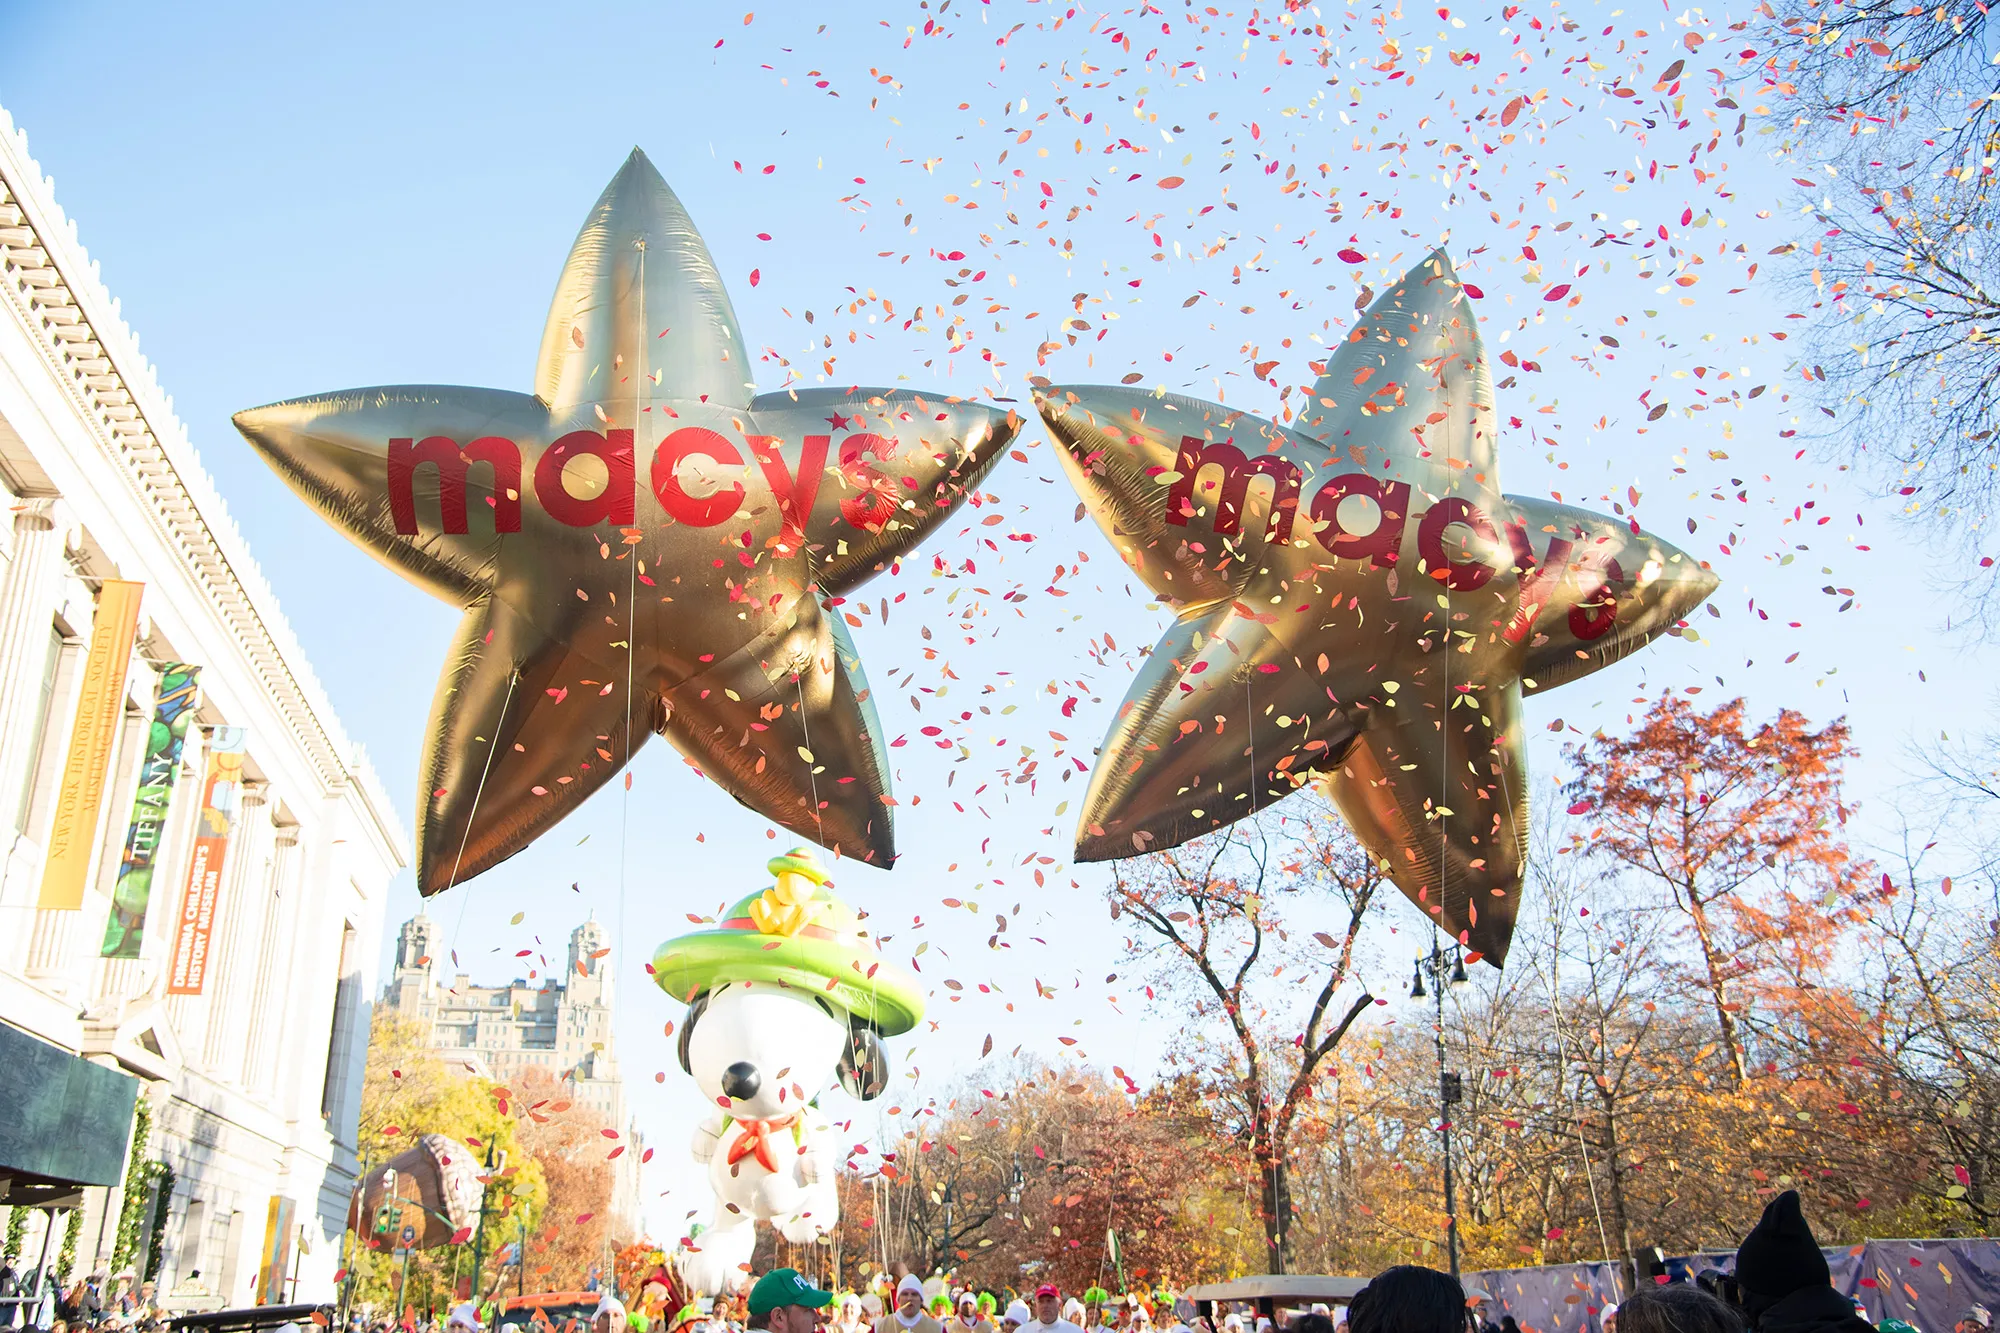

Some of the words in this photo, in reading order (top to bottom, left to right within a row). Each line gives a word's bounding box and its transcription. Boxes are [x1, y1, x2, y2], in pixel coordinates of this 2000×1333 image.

[52, 780, 80, 860] NEW-YORK
[71, 690, 98, 775] HISTORICAL
[88, 623, 113, 688] SOCIETY
[82, 750, 106, 813] MUSEUM
[104, 669, 123, 730] LIBRARY
[130, 752, 174, 861] TIFFANY
[173, 921, 196, 988] DIMENNA
[185, 844, 210, 920] CHILDREN'S
[187, 932, 208, 989] HISTORY
[197, 870, 219, 929] MUSEUM
